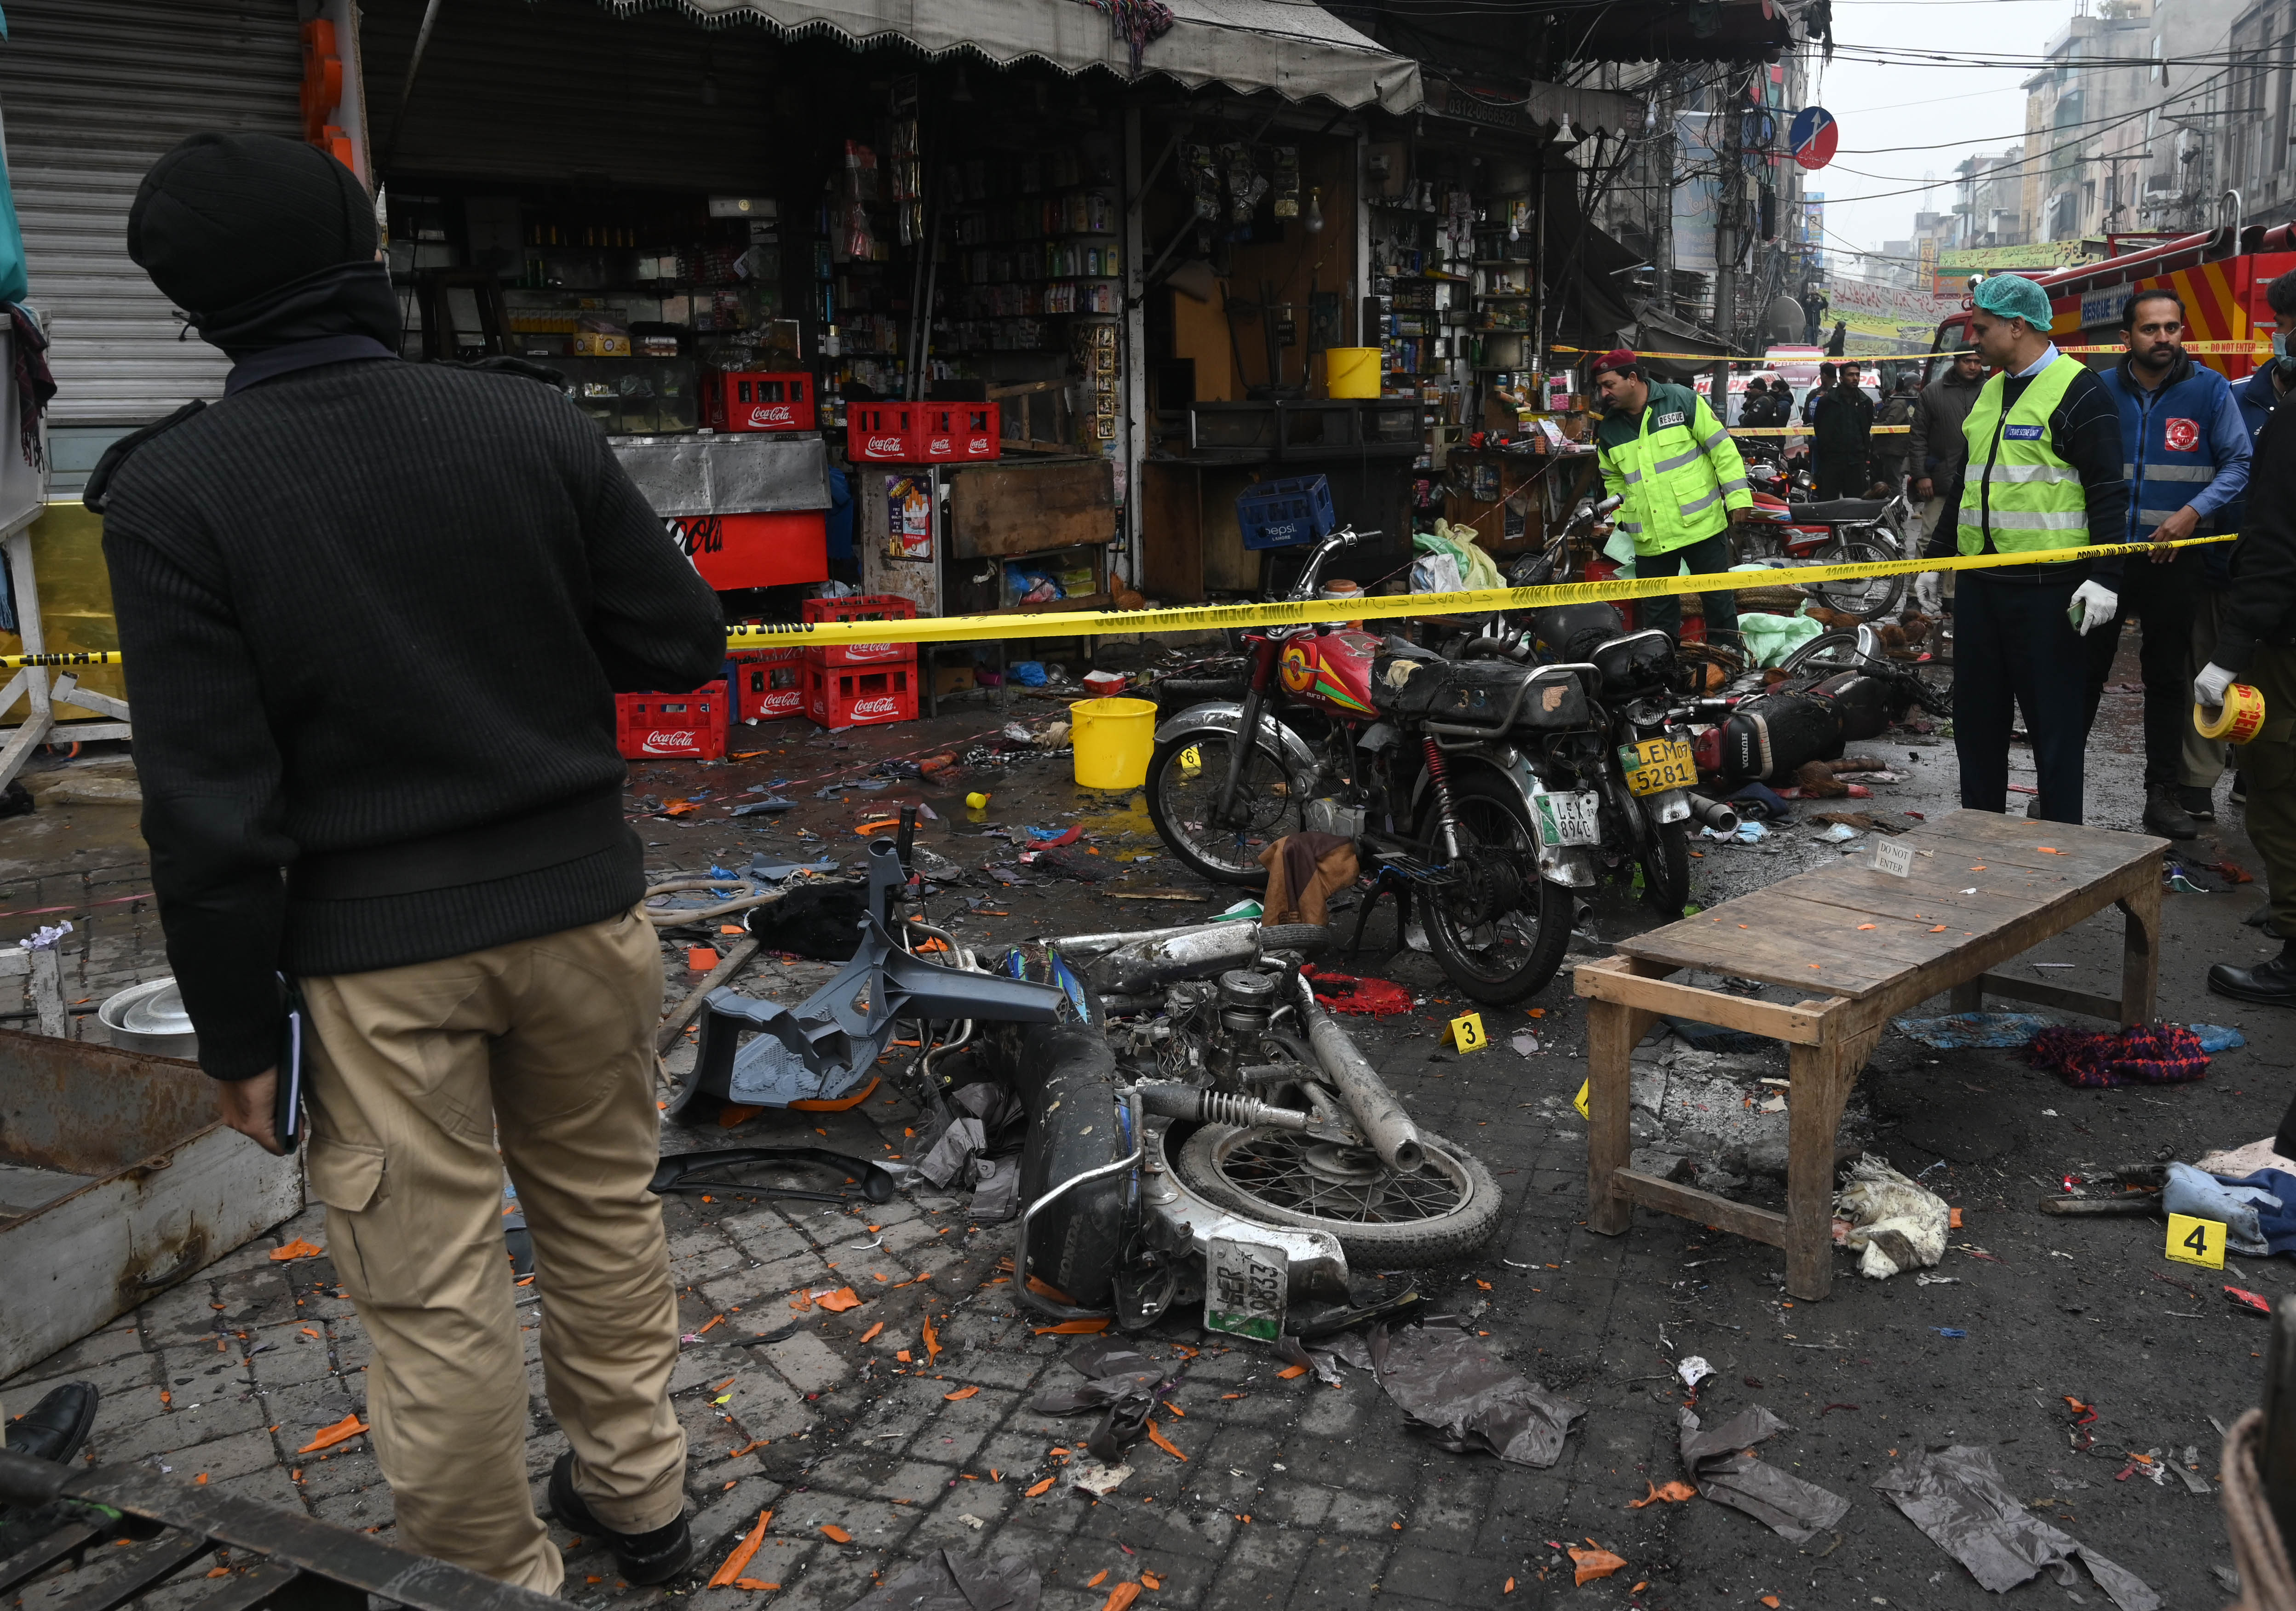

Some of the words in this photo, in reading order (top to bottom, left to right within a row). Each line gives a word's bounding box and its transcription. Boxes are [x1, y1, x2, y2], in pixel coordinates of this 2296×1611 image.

[1449, 99, 1517, 126] 0312-0666523
[2083, 298, 2111, 321] RESCUE
[2211, 343, 2220, 352] DO
[2221, 343, 2234, 352] NOT
[2236, 343, 2256, 352] ENTER
[752, 406, 791, 421] Coca-Cola
[1659, 413, 1683, 425] RESCUE
[868, 436, 901, 452] Coca-Cola
[931, 439, 949, 449] Coca-Cola
[970, 438, 987, 449] Coca-Cola
[764, 692, 802, 708] Coca-Cola
[854, 697, 895, 714] Coca-Cola
[647, 730, 696, 746] Coca-Cola
[1187, 751, 1194, 763] 6
[1637, 743, 1678, 766] LEM
[1677, 744, 1687, 759] 07
[1636, 763, 1689, 790] 5281
[1880, 843, 1891, 854] DO
[1892, 848, 1909, 860] NOT
[1880, 857, 1903, 873] ENTER
[1462, 1021, 1476, 1044] 3
[2183, 1225, 2207, 1256] 4
